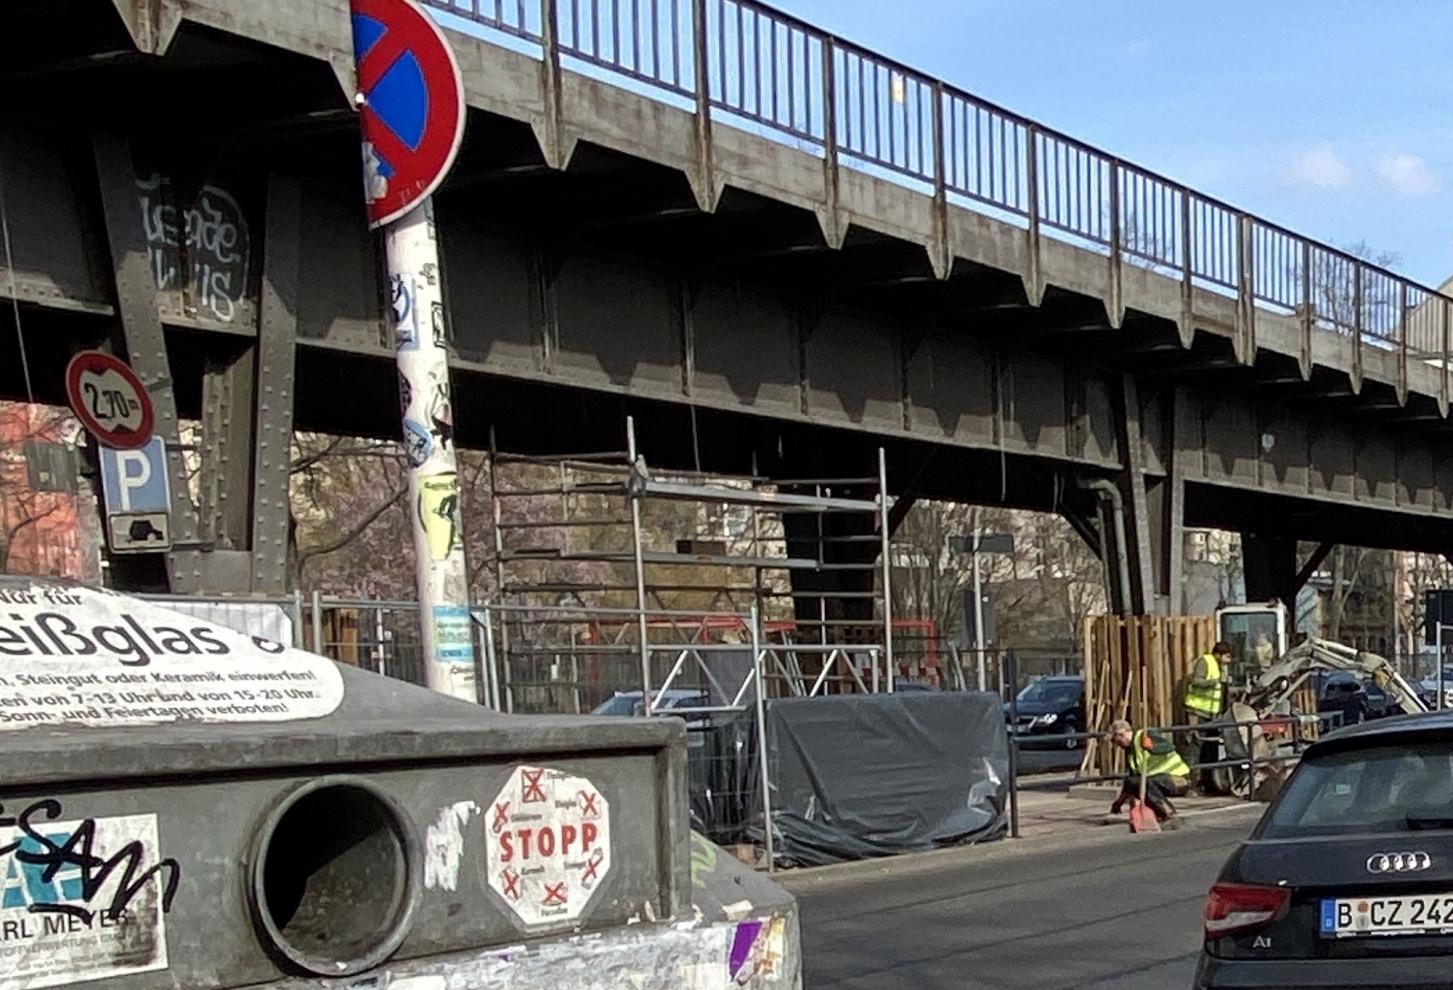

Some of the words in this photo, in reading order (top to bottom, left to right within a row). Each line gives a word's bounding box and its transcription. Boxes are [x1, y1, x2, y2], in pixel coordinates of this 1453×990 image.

[116, 450, 151, 511] P
[0, 612, 230, 667] eißglas
[15, 673, 102, 687] Steingut
[106, 673, 147, 684] oder
[151, 671, 225, 683] Keramik
[228, 669, 318, 682] einwerfen!
[31, 694, 70, 706] von
[119, 691, 149, 703] Uhr
[197, 689, 232, 701] von
[233, 688, 282, 700] 15-20
[63, 706, 101, 719] und
[104, 704, 203, 720] Feiertagen
[206, 702, 288, 714] verboten!
[499, 822, 598, 862] STOPP
[1338, 903, 1352, 928] B
[1371, 901, 1403, 926] CZ
[0, 918, 34, 940] RL
[1252, 935, 1272, 948] A1
